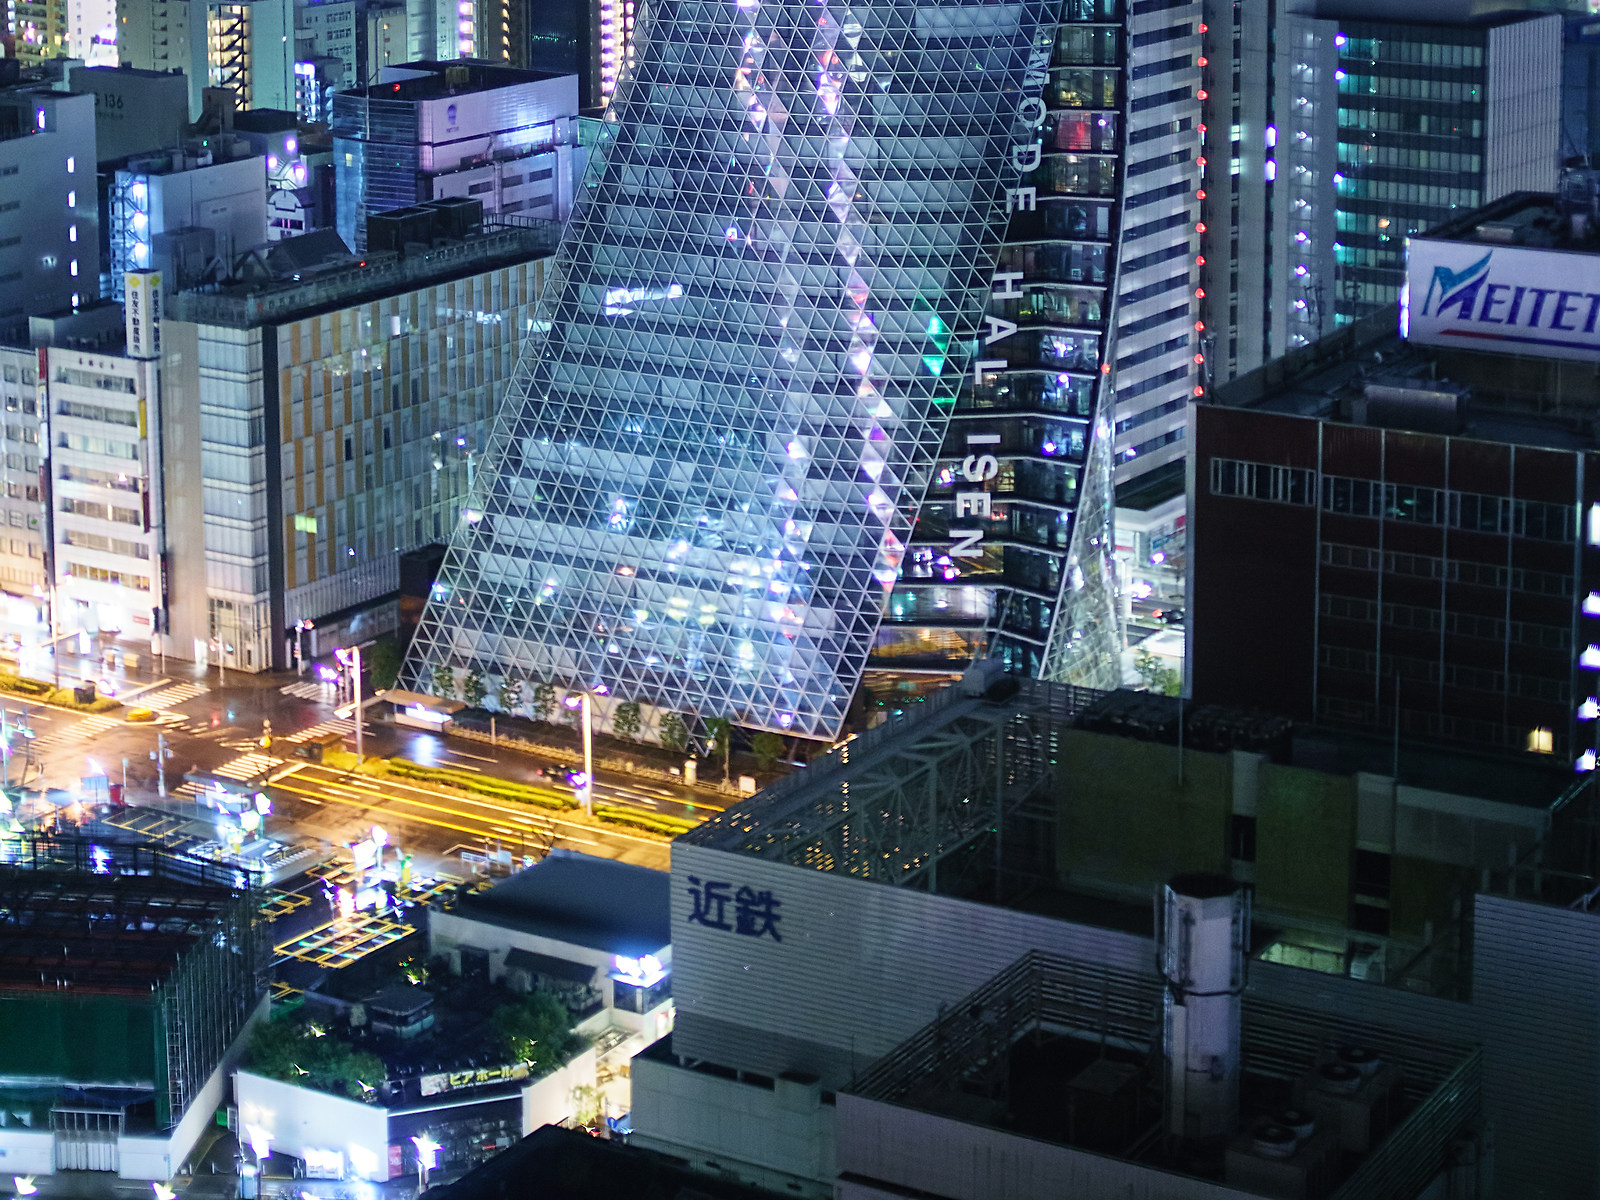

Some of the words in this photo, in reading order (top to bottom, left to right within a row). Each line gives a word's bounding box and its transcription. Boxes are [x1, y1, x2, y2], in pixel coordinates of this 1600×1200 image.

[1006, 51, 1051, 212] MODE
[974, 271, 1024, 386] HAL
[948, 434, 1001, 558] ISEN
[687, 874, 783, 942] 近鉄
